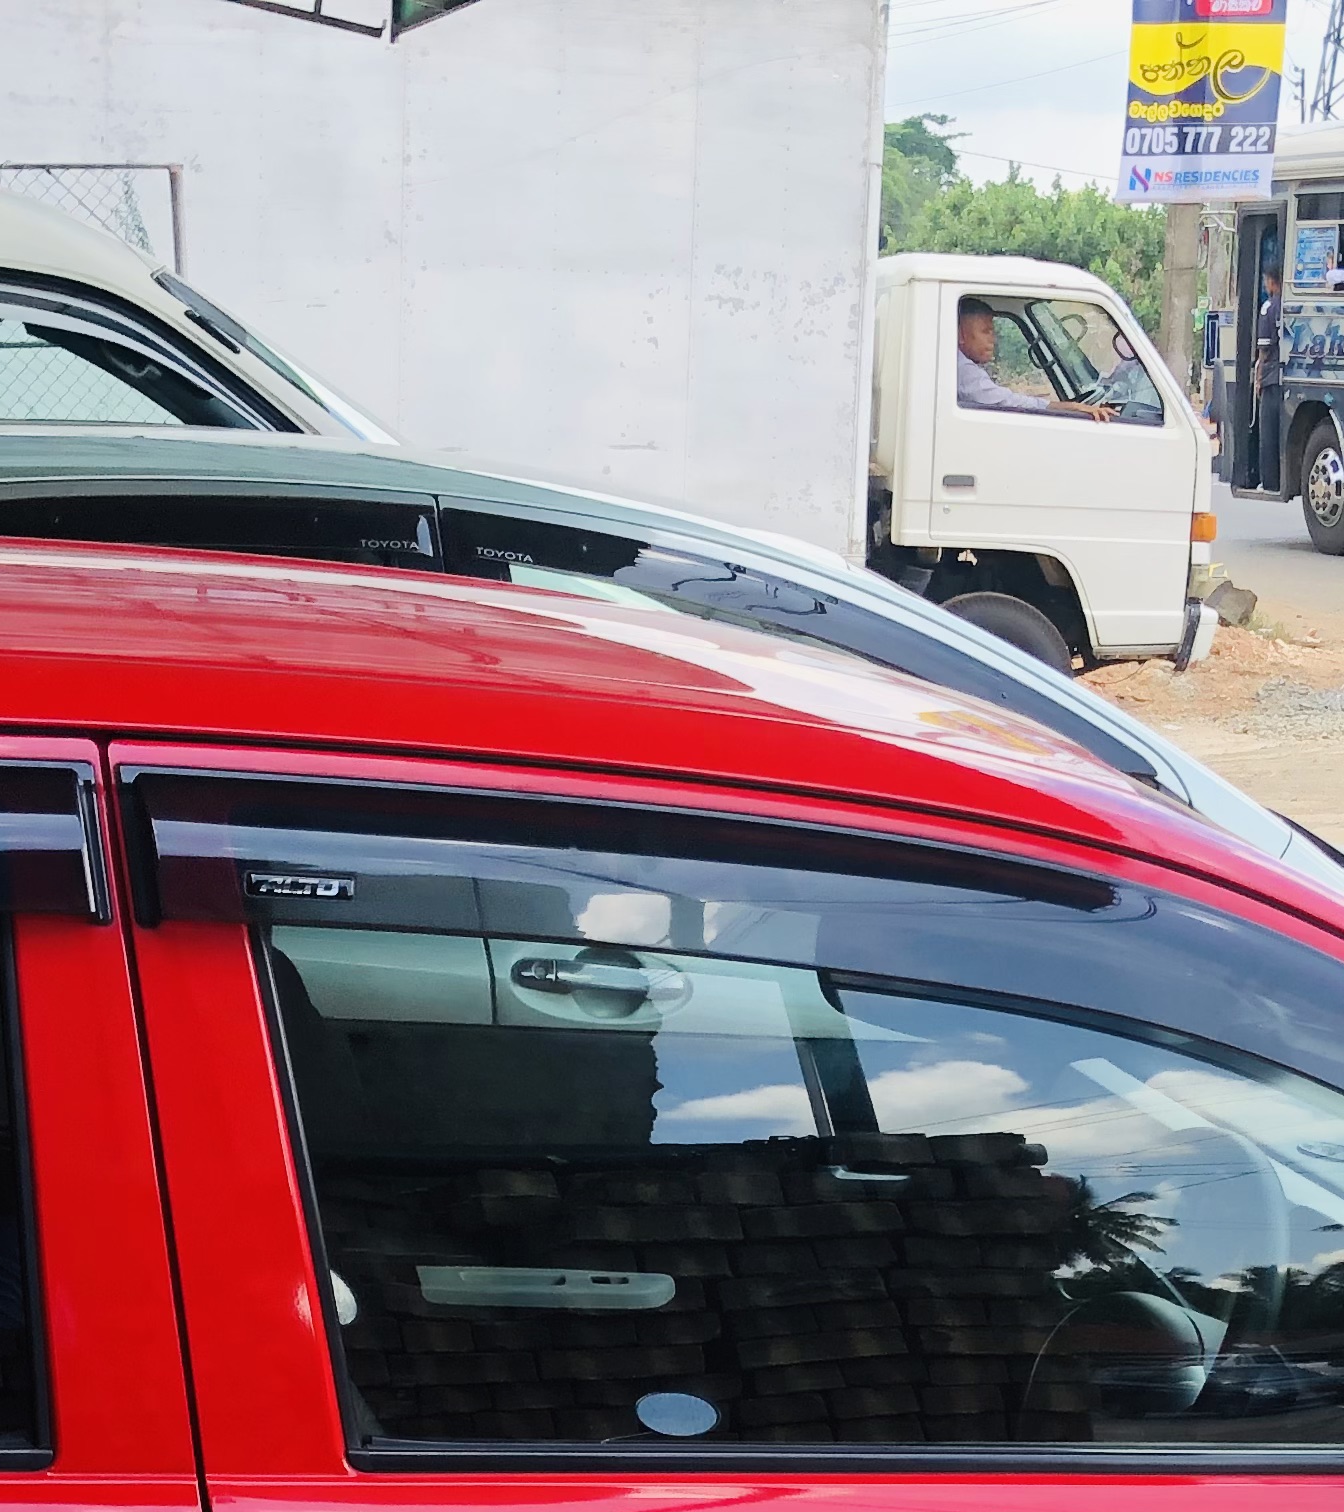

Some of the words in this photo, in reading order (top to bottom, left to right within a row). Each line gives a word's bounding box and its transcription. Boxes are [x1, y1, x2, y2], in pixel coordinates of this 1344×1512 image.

[1140, 32, 1271, 104] පන්නල
[1125, 126, 1178, 154] 0705
[1183, 126, 1222, 153] 777
[1229, 126, 1271, 153] 222
[1154, 170, 1173, 183] NS
[1174, 169, 1260, 184] RESIDENCIES
[360, 538, 420, 551] TOYOTA
[476, 546, 534, 563] TOYOTA
[258, 875, 340, 897] ALTO
